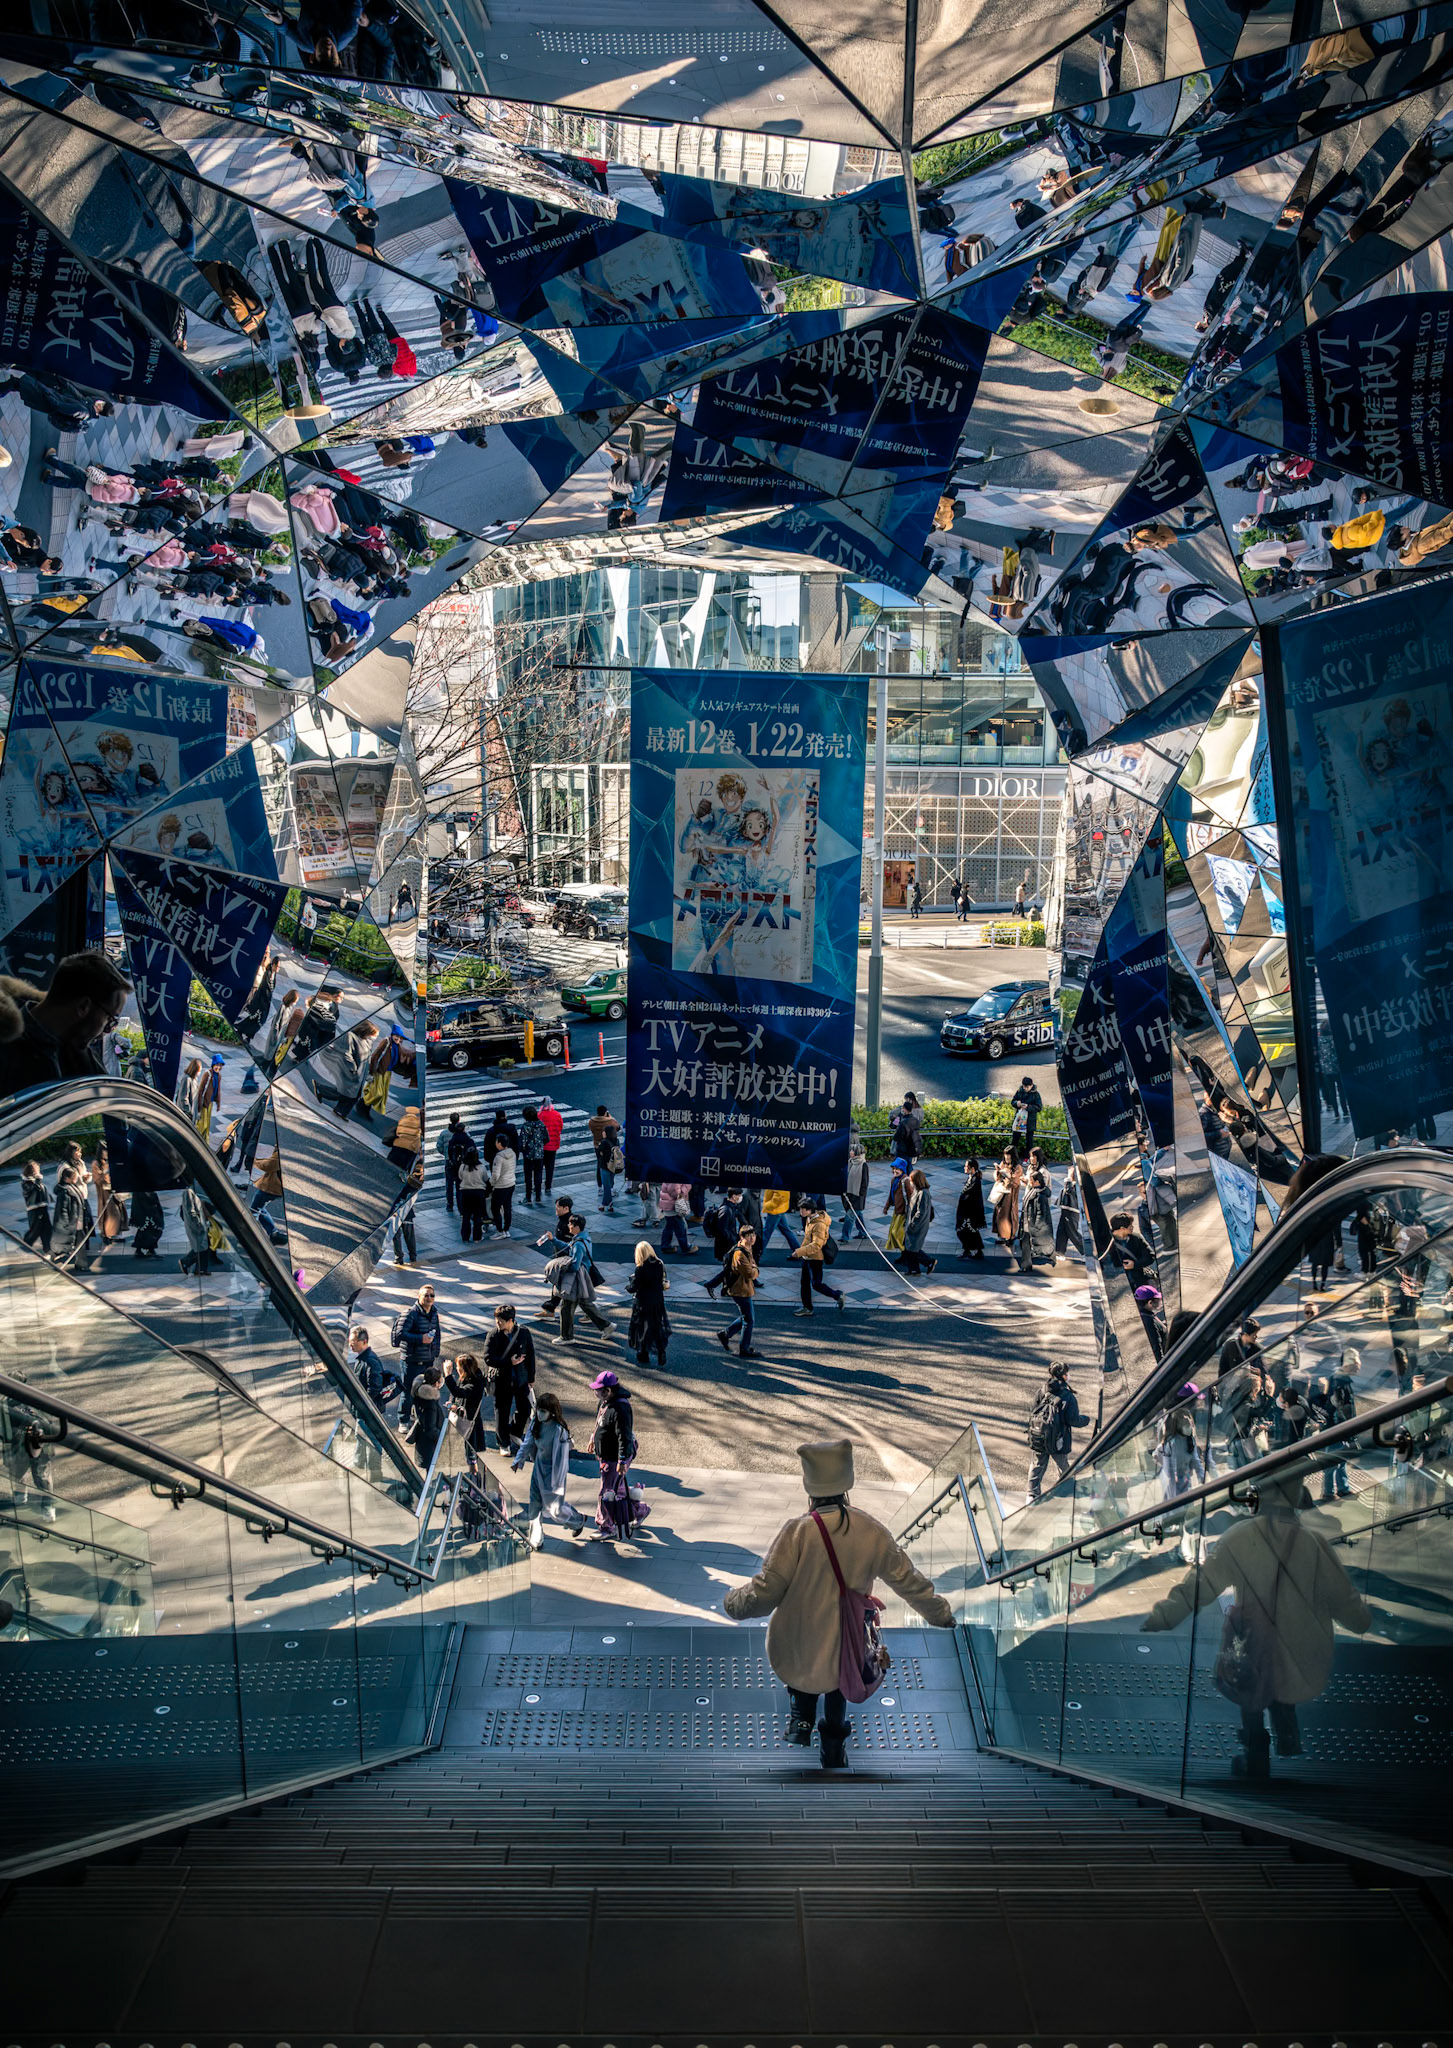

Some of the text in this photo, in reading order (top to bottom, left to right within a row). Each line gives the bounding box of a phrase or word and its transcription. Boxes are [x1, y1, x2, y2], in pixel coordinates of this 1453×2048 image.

[699, 699, 800, 715] 大人気フィギュアスケート漫画
[698, 779, 714, 797] 12
[973, 777, 1040, 799] DIOR
[802, 886, 816, 900] 12
[640, 1018, 765, 1055] TVアニメ
[640, 1058, 838, 1109] 大好評放送中!
[779, 1120, 799, 1130] AND
[724, 1164, 771, 1175] KODANSHA
